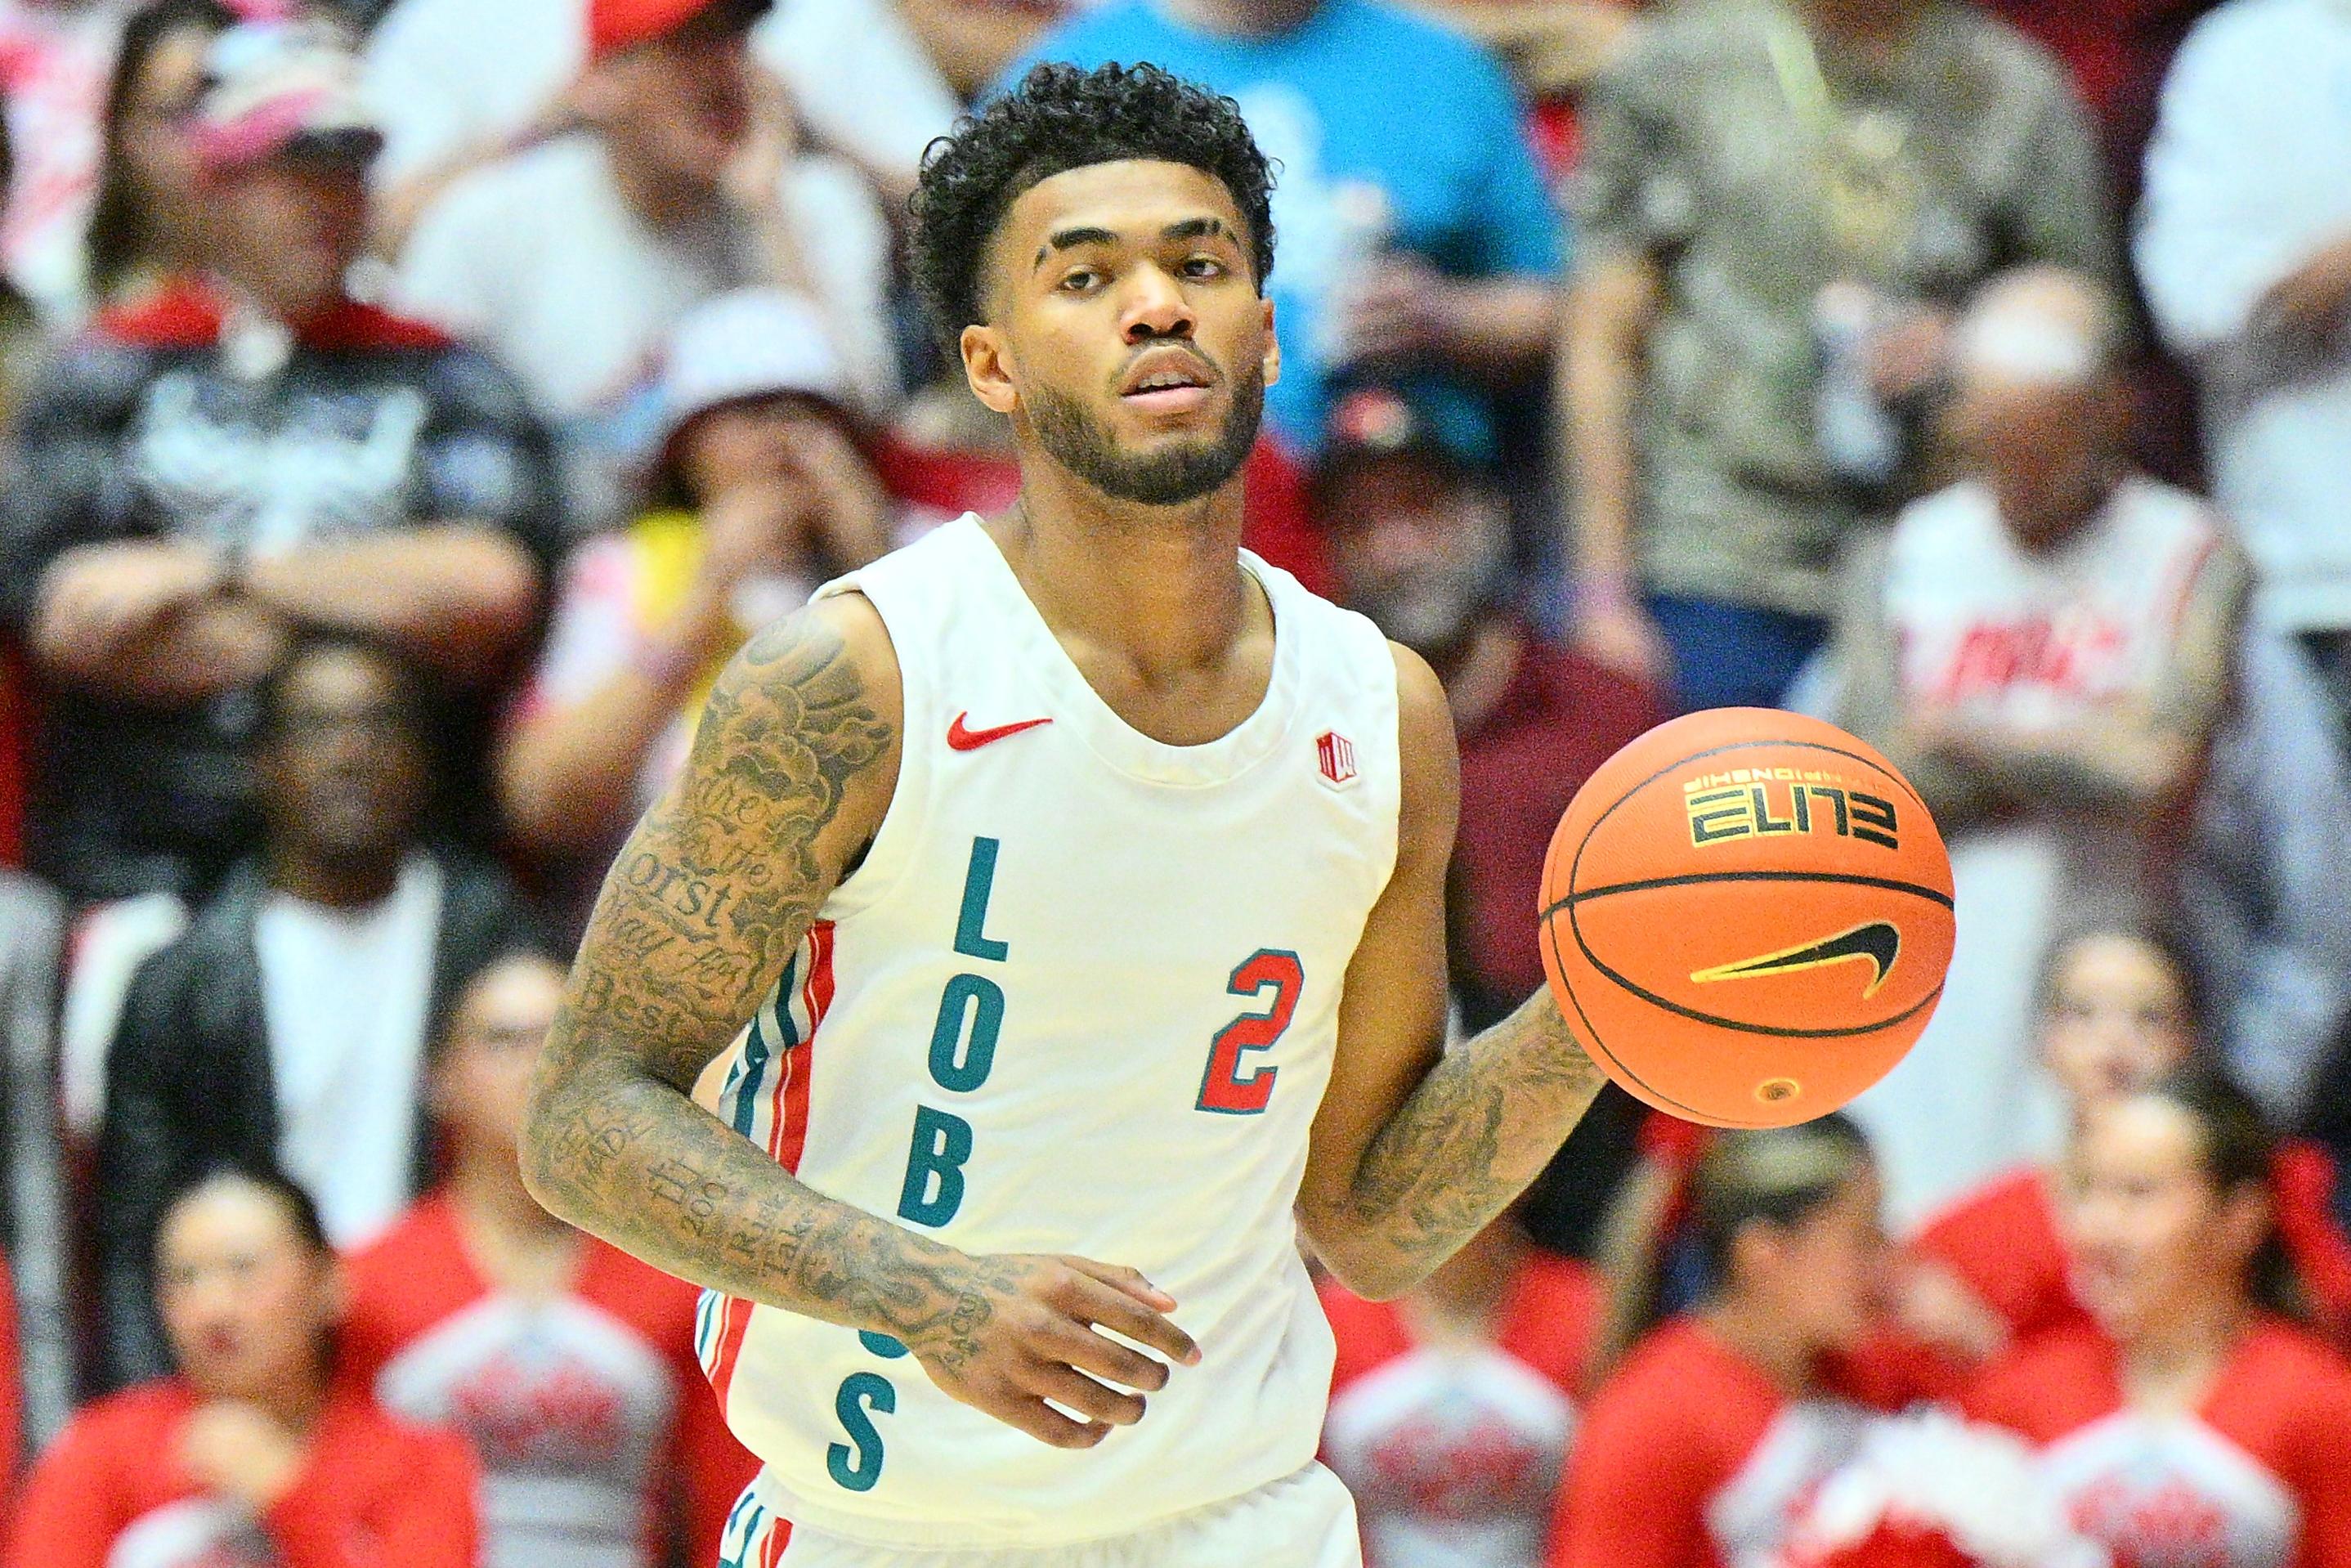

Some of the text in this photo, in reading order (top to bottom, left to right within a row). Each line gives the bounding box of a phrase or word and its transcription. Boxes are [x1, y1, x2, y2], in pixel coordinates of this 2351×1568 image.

[1685, 782, 1899, 850] ELITE
[628, 852, 732, 929] orst
[1194, 948, 1305, 1115] 2
[826, 836, 1009, 1492] LOBS
